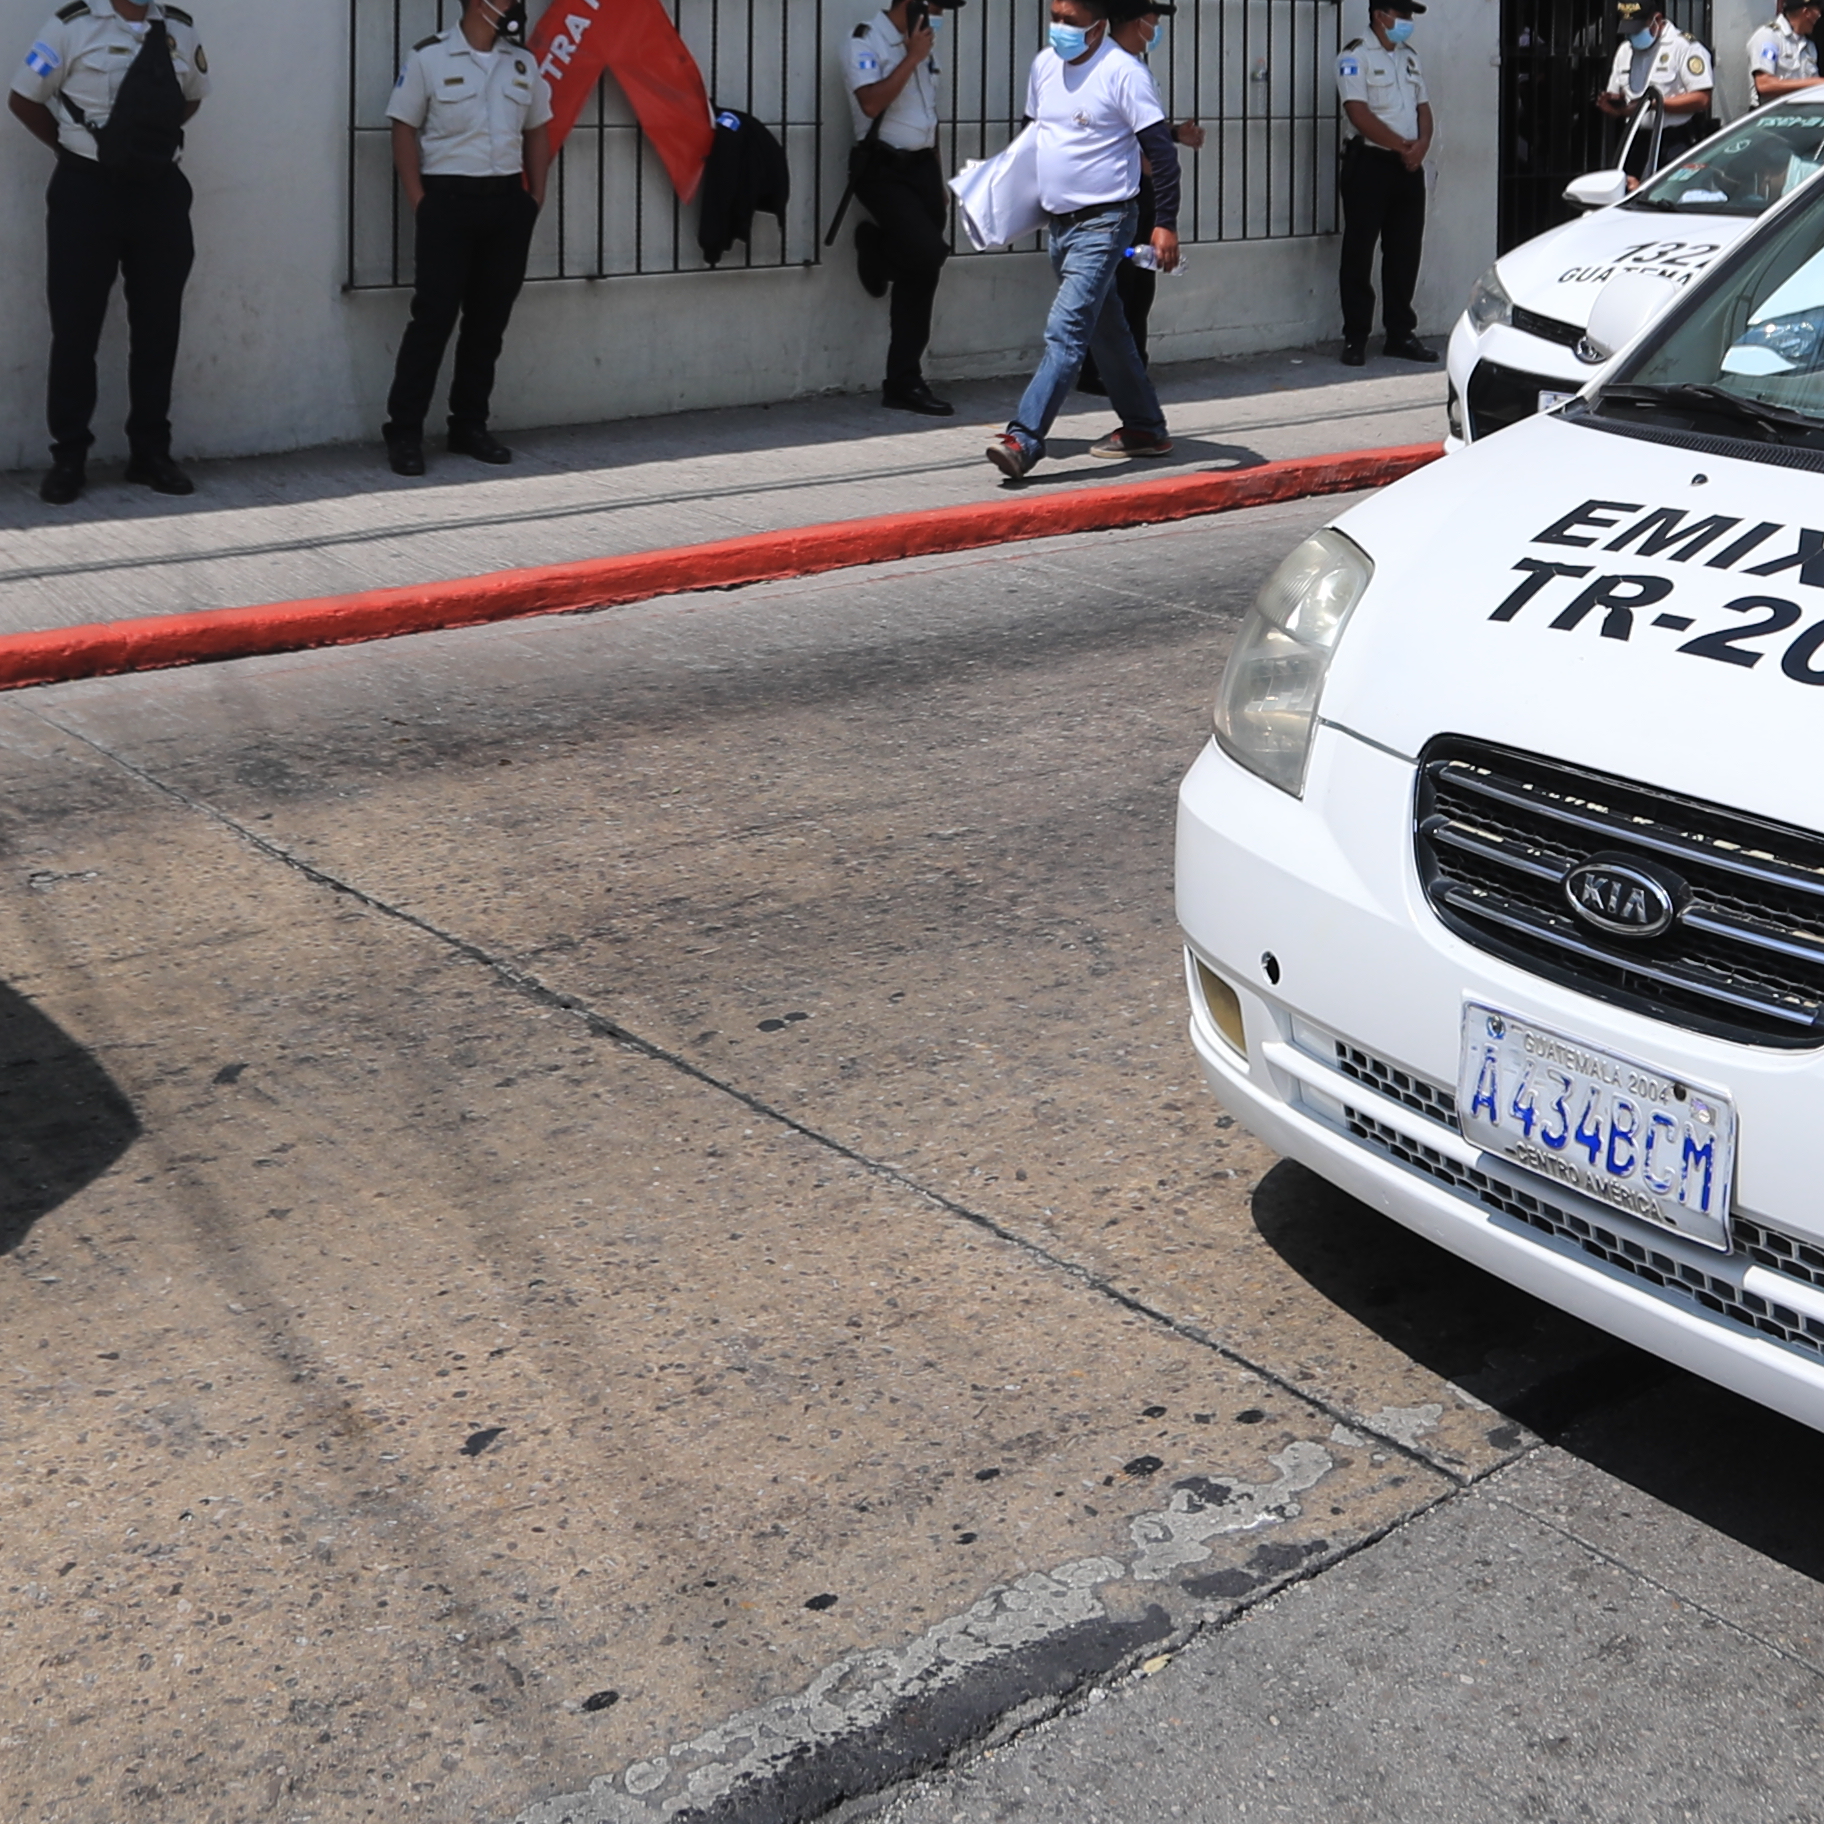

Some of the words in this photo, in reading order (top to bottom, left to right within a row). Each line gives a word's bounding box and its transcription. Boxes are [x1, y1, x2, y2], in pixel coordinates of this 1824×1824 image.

[1582, 872, 1648, 924] KIA
[1524, 1030, 1623, 1088] GUATEMALA
[1628, 1071, 1671, 1105] 2004
[1515, 1140, 1577, 1184] CENTRO
